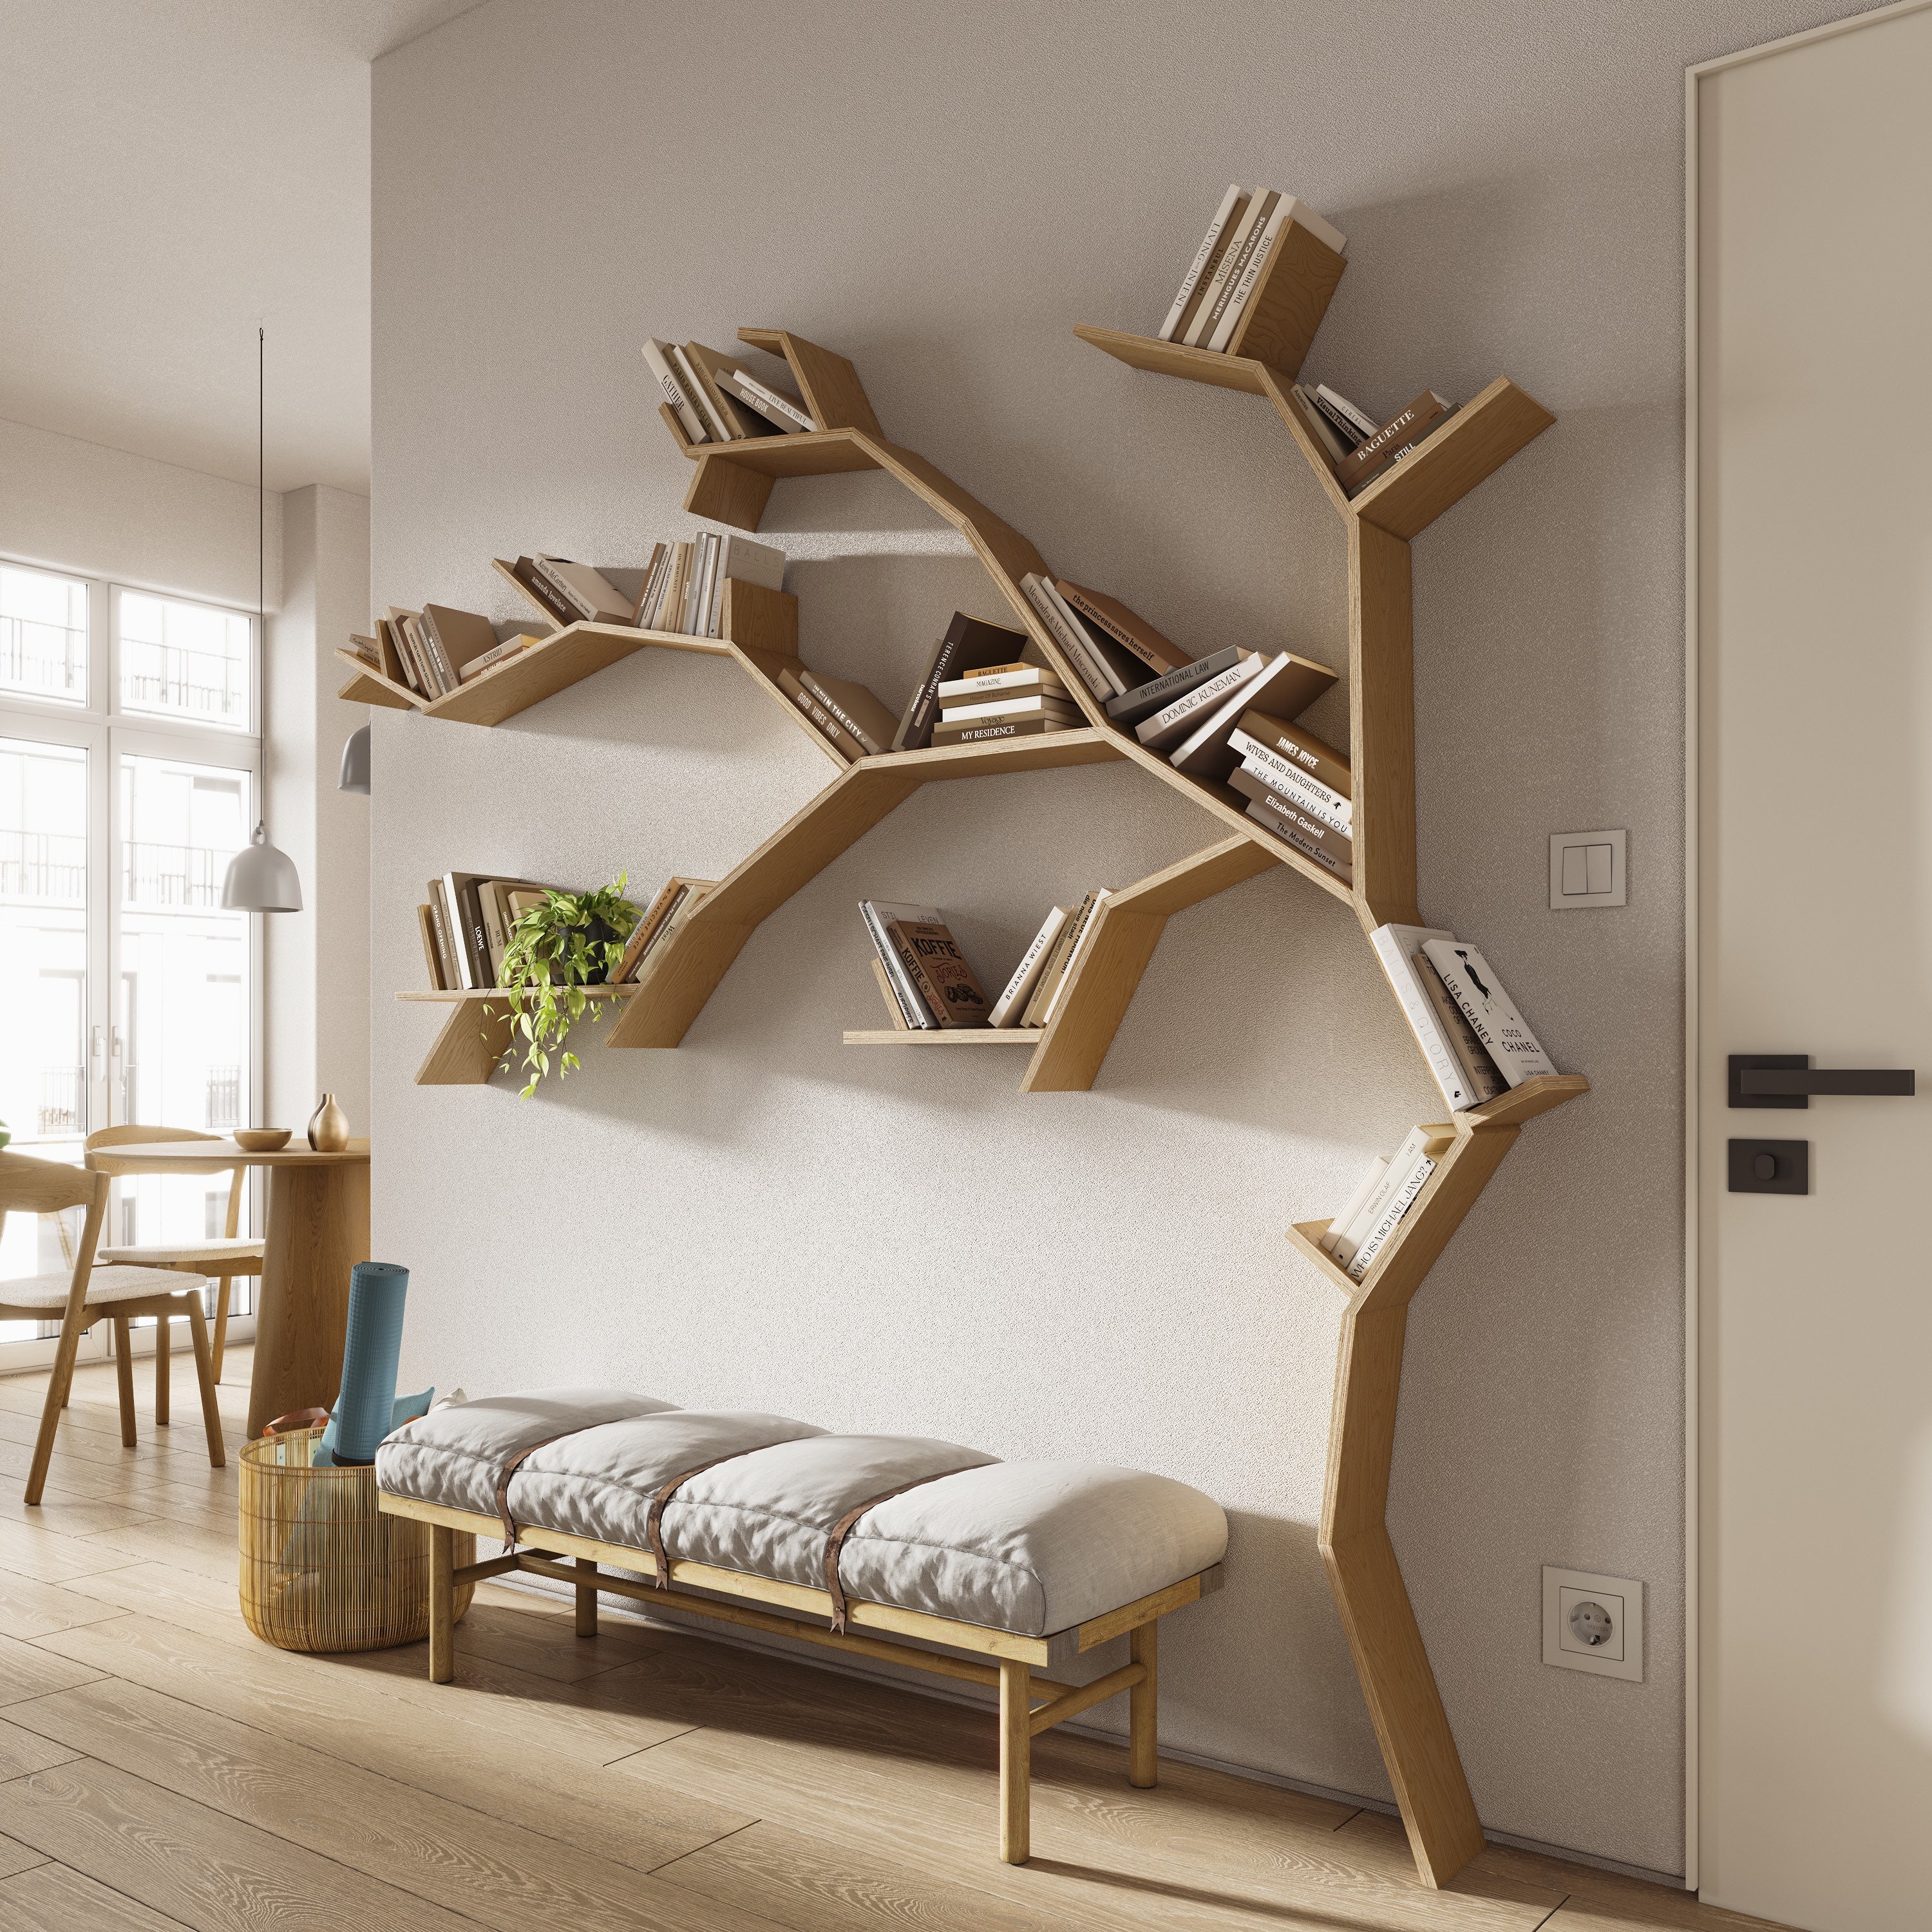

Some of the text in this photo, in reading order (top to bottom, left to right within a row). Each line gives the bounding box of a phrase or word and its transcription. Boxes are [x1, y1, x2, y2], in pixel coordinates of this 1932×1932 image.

[1175, 223, 1220, 308] LIVING INTENT
[1197, 248, 1224, 296] INSTANBUL
[1212, 216, 1265, 320] MERINGUES MACARONS
[1234, 235, 1273, 305] THE THIN JUSTICE
[663, 375, 685, 412] GATHER
[673, 363, 711, 428] PARIS PASTRY CLUB
[696, 362, 728, 417] JOHN GALLIANO DIOR
[739, 388, 756, 404] HOUSE
[755, 399, 769, 413] BOOK
[769, 395, 781, 406] LIVE
[780, 403, 806, 425] BEAUTIFUL
[1341, 406, 1361, 425] CEREAL
[1356, 410, 1414, 461] BAGUETTE
[1382, 443, 1401, 459] Paris
[1394, 442, 1416, 462] STILL
[734, 544, 779, 567] BALLS
[538, 560, 567, 592] Karen McCartney
[531, 576, 548, 596] amanda
[548, 591, 566, 612] lovelace
[711, 586, 721, 623] GLORY
[1072, 594, 1155, 661] the princess saves herself
[925, 641, 954, 699] TERENCE CONRAN'S
[976, 677, 1001, 687] MAGAZINE
[978, 667, 1008, 677] BAGUETTE
[1071, 648, 1101, 689] Misczynski
[1139, 661, 1209, 699] INTERNATIONAL LAW
[911, 684, 925, 712] barcelona
[992, 690, 1010, 699] Boheme
[1162, 669, 1242, 724] DOMINIC KUNEMAN
[797, 692, 840, 739] GOOD VIBES ONLY
[823, 696, 862, 738] IN THE CITY
[980, 715, 1005, 726] Voyage
[961, 725, 1016, 740] MY RESIDENCE
[1276, 736, 1319, 770] JAMES JOYCE
[1245, 741, 1331, 803] WIVES AND DAUGHTERS
[1253, 767, 1348, 833] THE MOUNTAIN IS YOU
[1265, 795, 1325, 839] Elizabeth Gaskell
[1276, 822, 1336, 867] The Modern Sunset
[643, 891, 685, 956] TIME PLACE NORDIC CUISINE
[645, 902, 663, 931] VACCINE
[881, 911, 939, 924] STIL LEVEN
[1075, 907, 1084, 922] neue
[438, 929, 447, 959] OPENING
[467, 917, 479, 961] CONSIDERED
[475, 926, 484, 951] LOEWE
[633, 933, 645, 950] RACE
[661, 925, 675, 941] West
[1068, 923, 1077, 940] stadt
[902, 947, 924, 982] KOFFIE
[911, 937, 962, 960] KOFFIE
[1046, 957, 1056, 971] GUIDE
[930, 962, 967, 983] STORIES
[1005, 933, 1046, 1000] BRIANNA WIEST
[927, 992, 944, 1015] STORIES
[1032, 987, 1043, 1003] DESIGN
[1379, 936, 1456, 1081] BALLS & GLORY
[1444, 974, 1461, 999] LISA
[1462, 1002, 1493, 1046] CHANEY
[1501, 1041, 1540, 1052] CHANEL
[1502, 1029, 1521, 1037] COCO
[1408, 1144, 1416, 1153] AM
[1368, 1182, 1390, 1215] ERWIN OLAF
[1352, 1166, 1428, 1278] WHO IS MICHAEL JANG?
